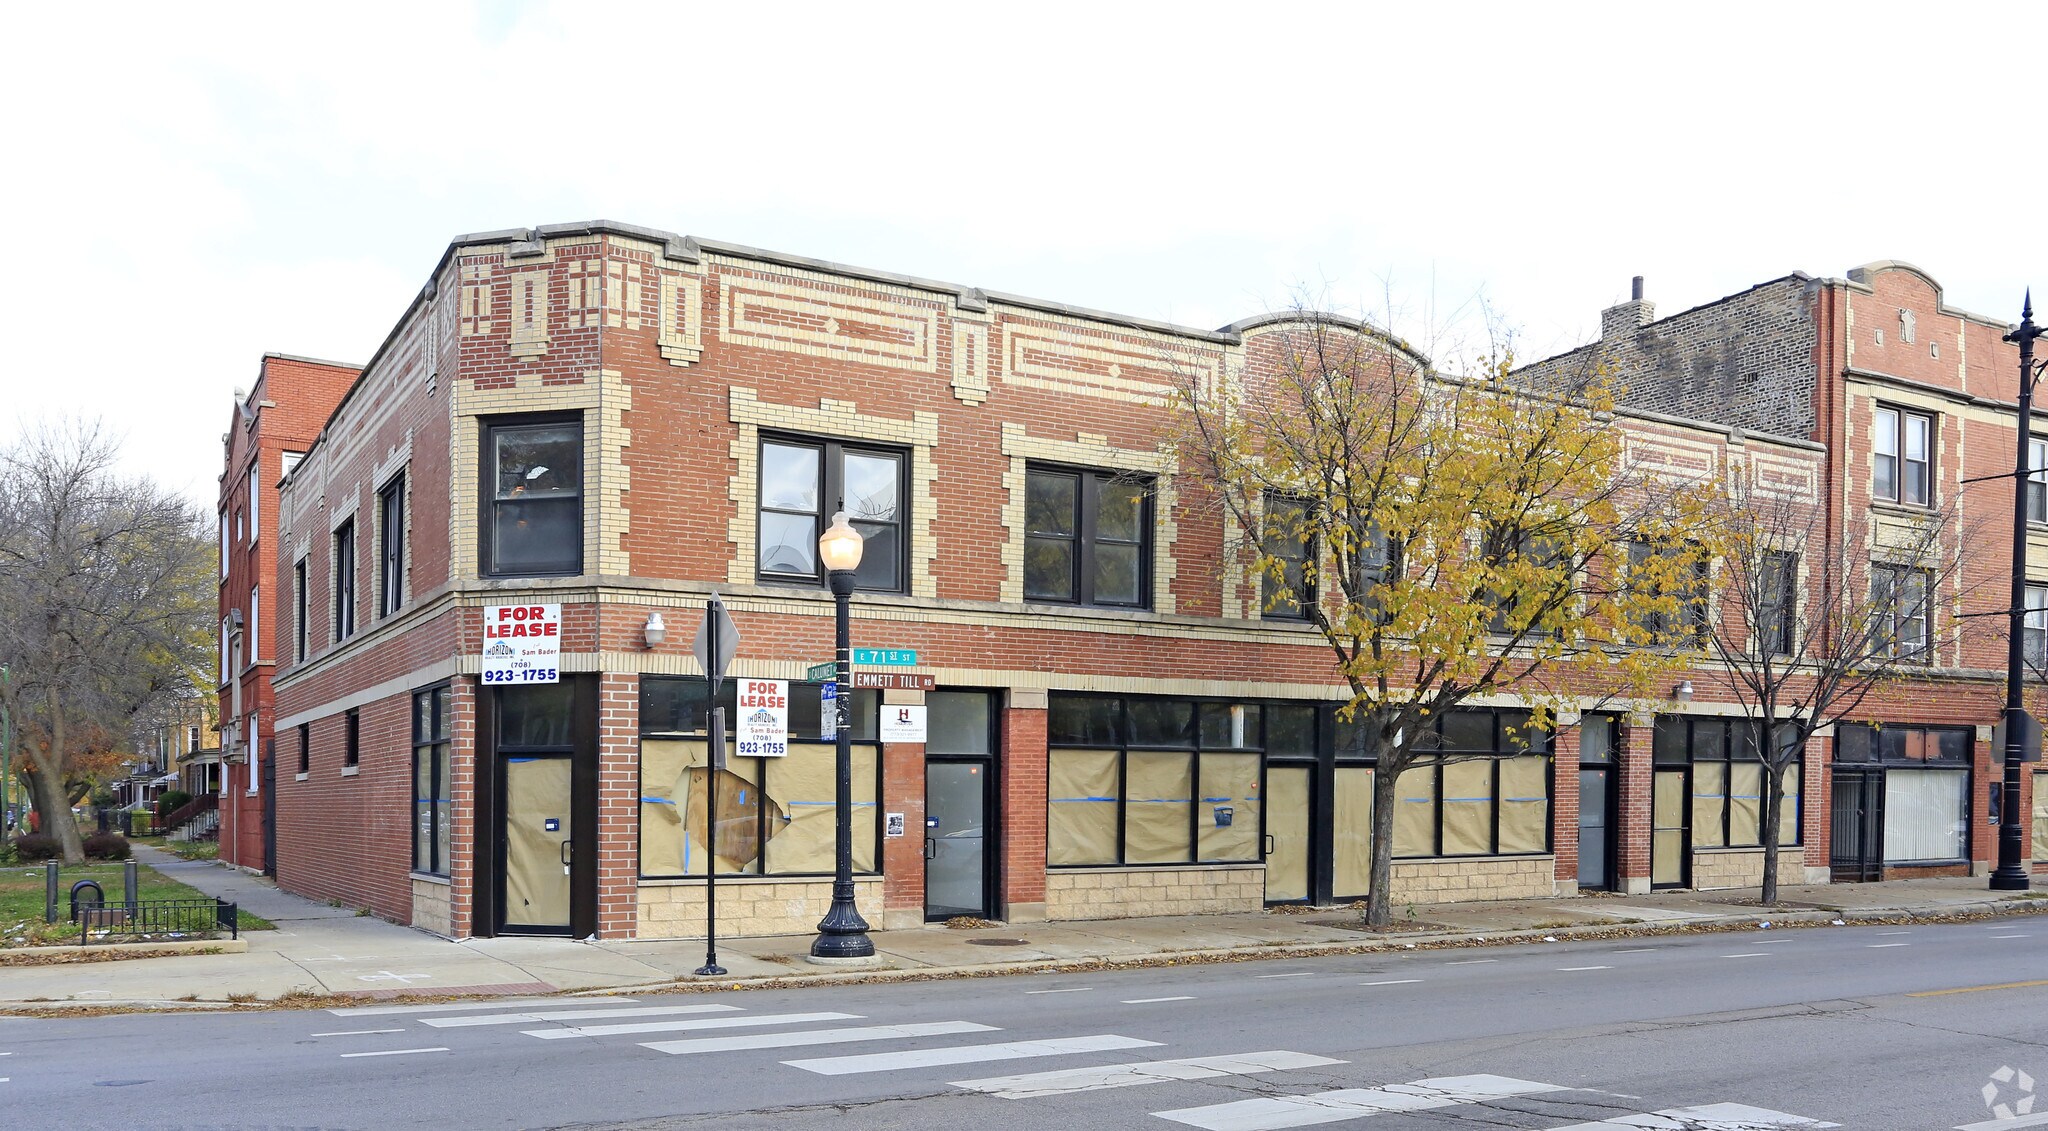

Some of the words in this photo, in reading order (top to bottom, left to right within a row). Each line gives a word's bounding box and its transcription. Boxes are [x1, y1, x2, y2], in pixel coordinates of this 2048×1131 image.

[498, 606, 545, 621] FOR
[486, 622, 558, 638] LEASE
[486, 644, 514, 655] HORIZON
[860, 653, 865, 661] E
[484, 668, 557, 682] 923-1755
[857, 673, 894, 687] EMMETT
[900, 675, 920, 688] TILL
[923, 678, 932, 686] RD
[748, 682, 777, 695] FOR
[740, 694, 785, 708] LEASE
[748, 712, 776, 724] HORIZON
[739, 741, 785, 754] 923-1755
